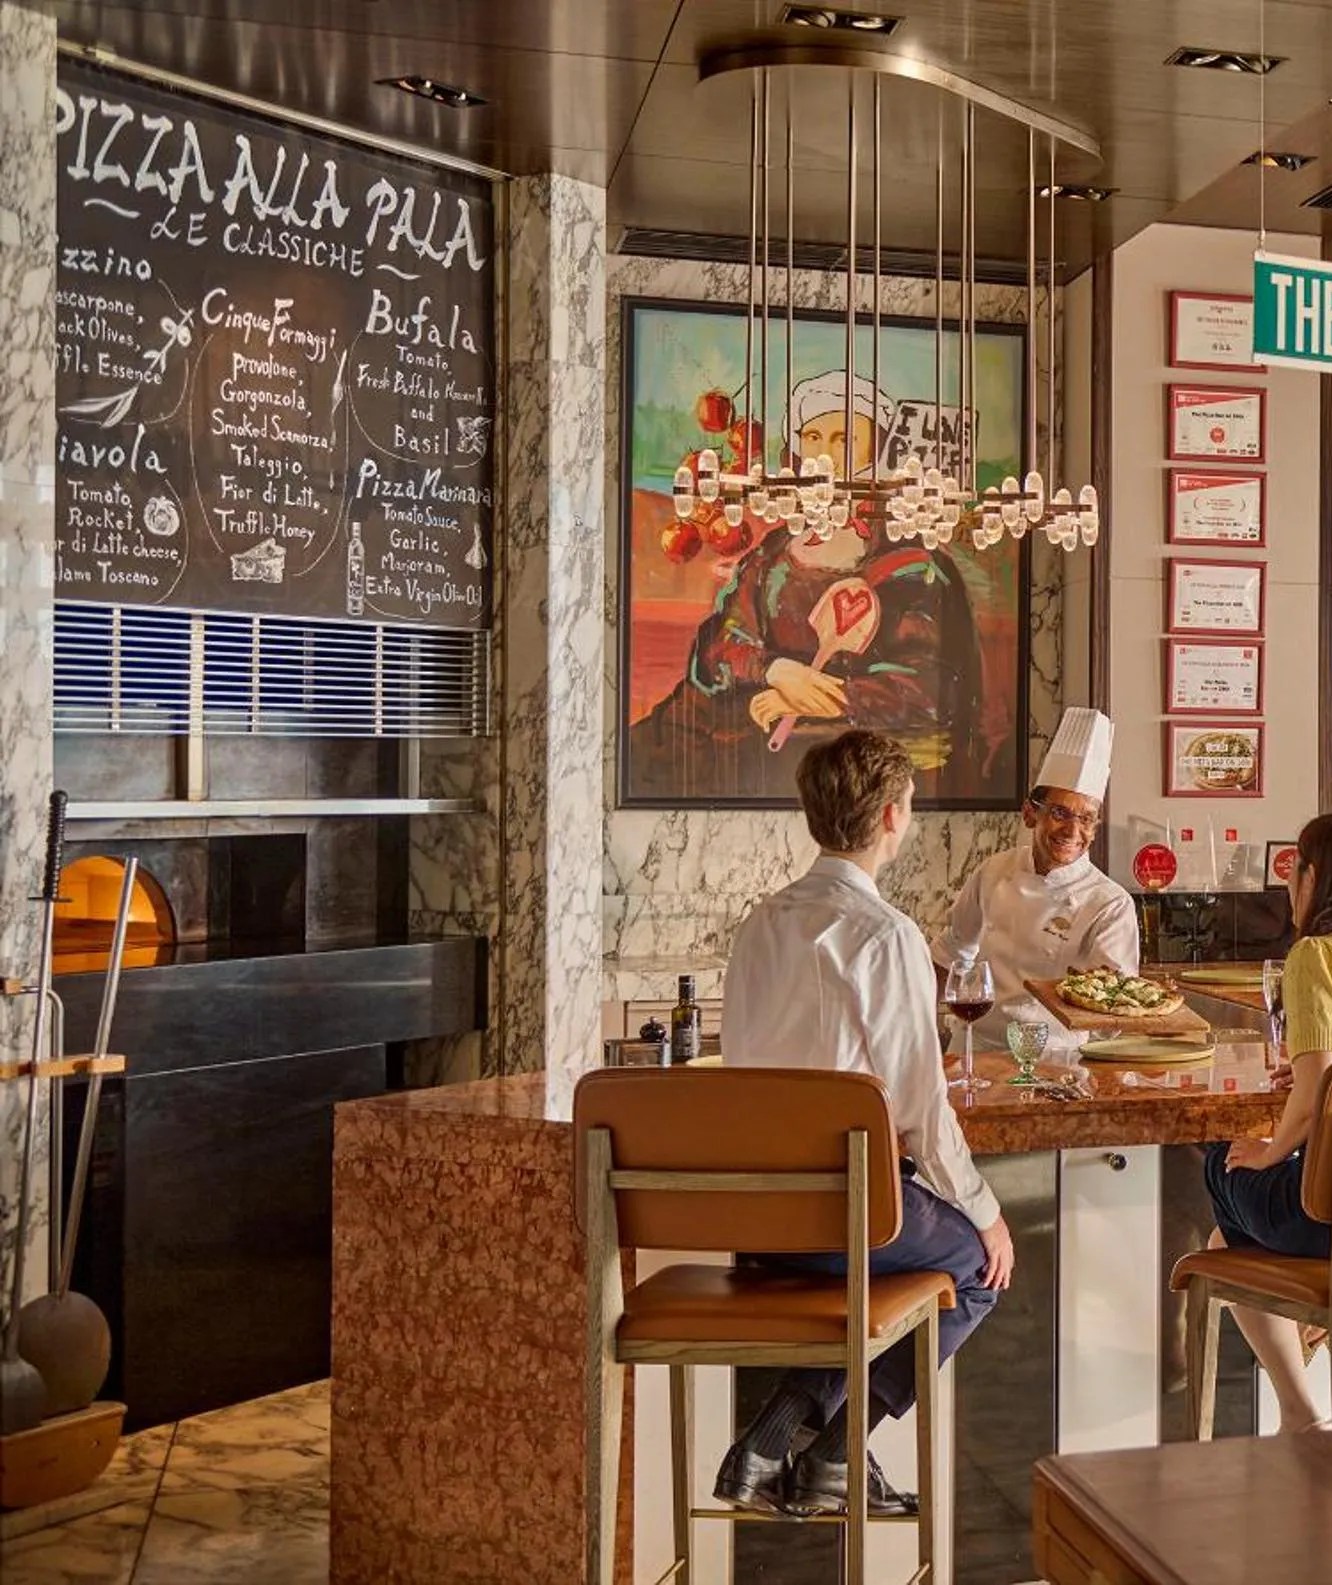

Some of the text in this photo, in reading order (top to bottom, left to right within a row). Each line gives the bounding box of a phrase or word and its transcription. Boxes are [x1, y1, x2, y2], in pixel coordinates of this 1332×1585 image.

[222, 134, 350, 230] ALLA
[365, 177, 485, 272] PALA
[150, 206, 365, 277] LE CLASSICHE
[365, 289, 477, 355] Bufala
[98, 352, 163, 384] Essence
[212, 408, 268, 438] Smoked
[411, 403, 434, 422] and
[895, 405, 918, 436] I
[394, 424, 449, 456] Basil
[220, 475, 253, 500] Fior
[263, 481, 278, 504] di
[356, 458, 492, 508] Pizza Marinara
[213, 508, 316, 550] Truffle Honey
[381, 502, 424, 525] Tomato
[72, 529, 87, 553] di
[97, 561, 160, 587] Toscano
[366, 575, 402, 597] Extra
[406, 578, 441, 614] Virgin
